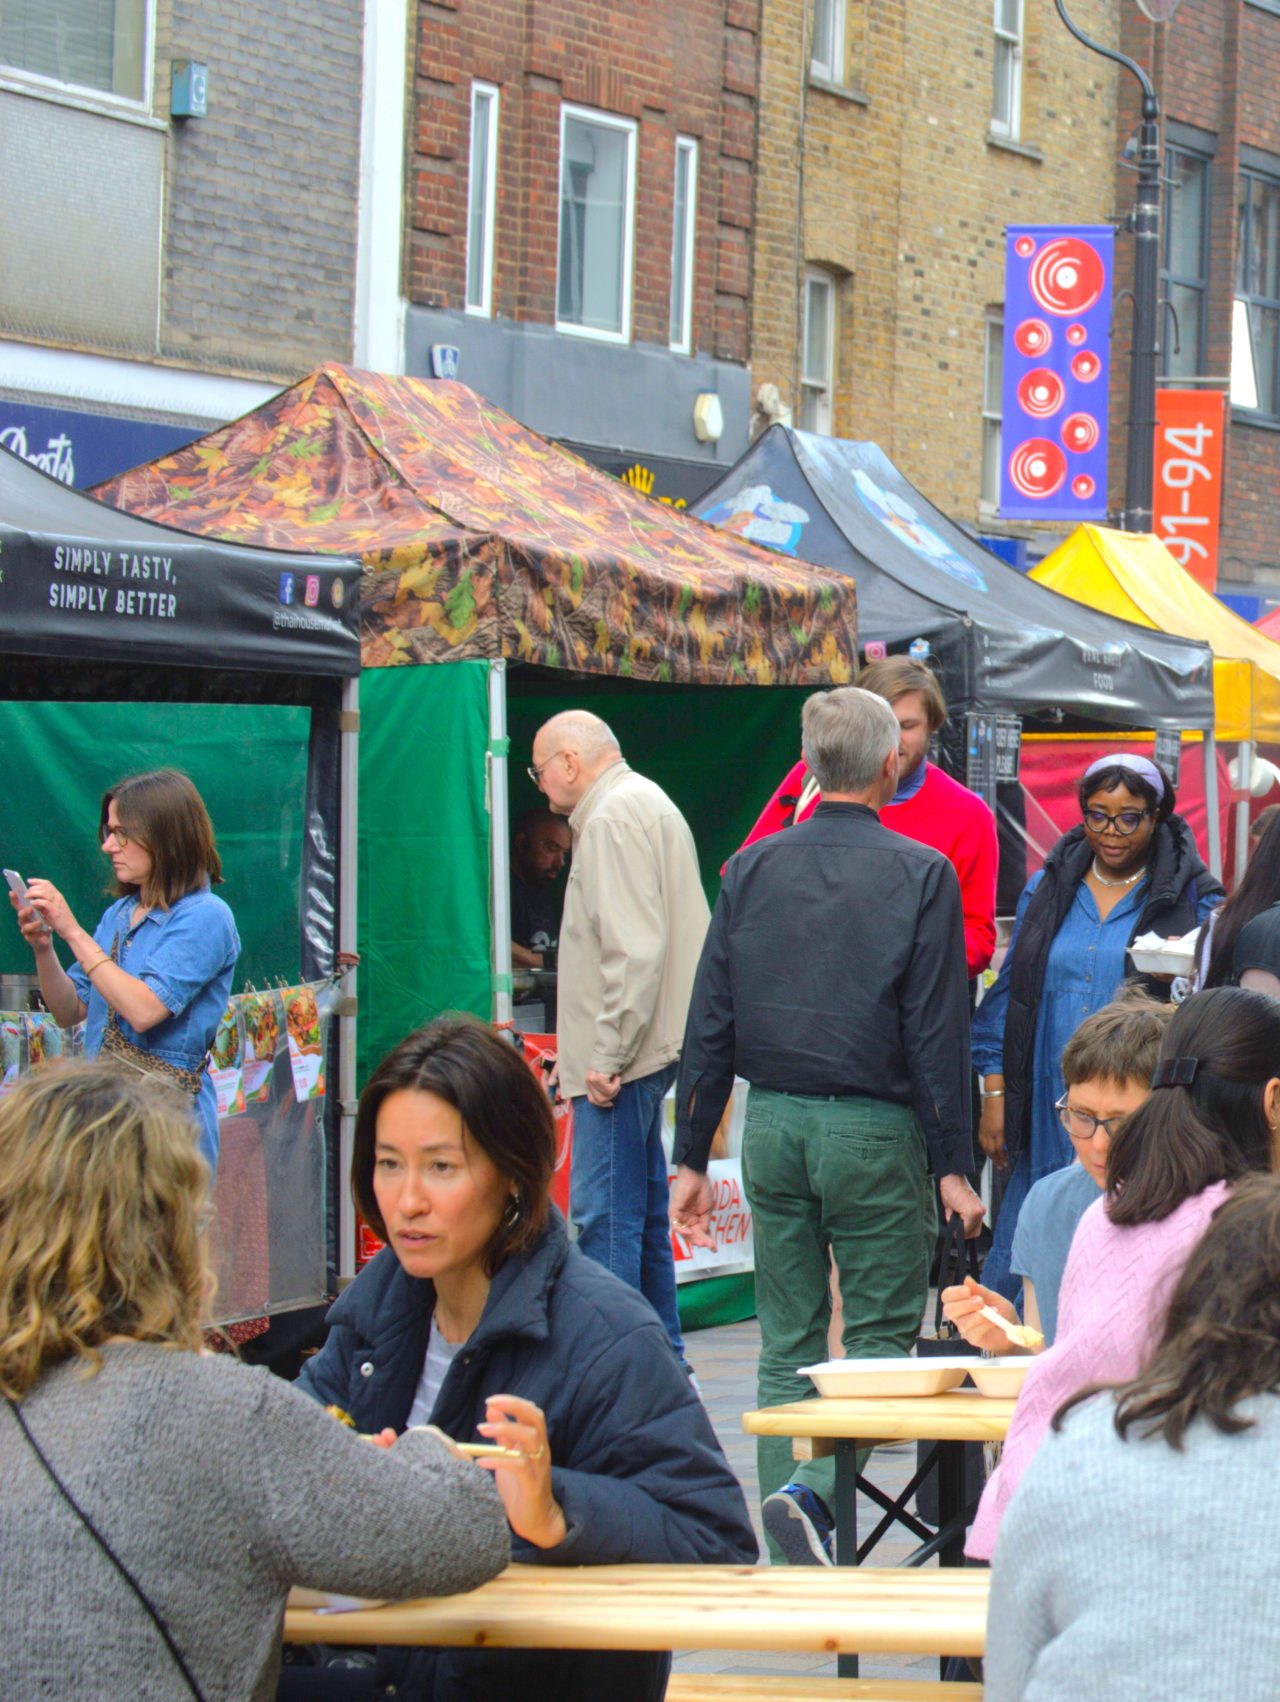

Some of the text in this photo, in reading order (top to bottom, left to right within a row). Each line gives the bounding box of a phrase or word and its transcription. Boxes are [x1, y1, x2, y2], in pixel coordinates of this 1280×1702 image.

[1160, 421, 1213, 566] 91-94
[54, 546, 177, 586] SIMPLY TASTY,
[49, 583, 177, 618] SIMPLY BETTER
[1093, 671, 1114, 690] FOOD
